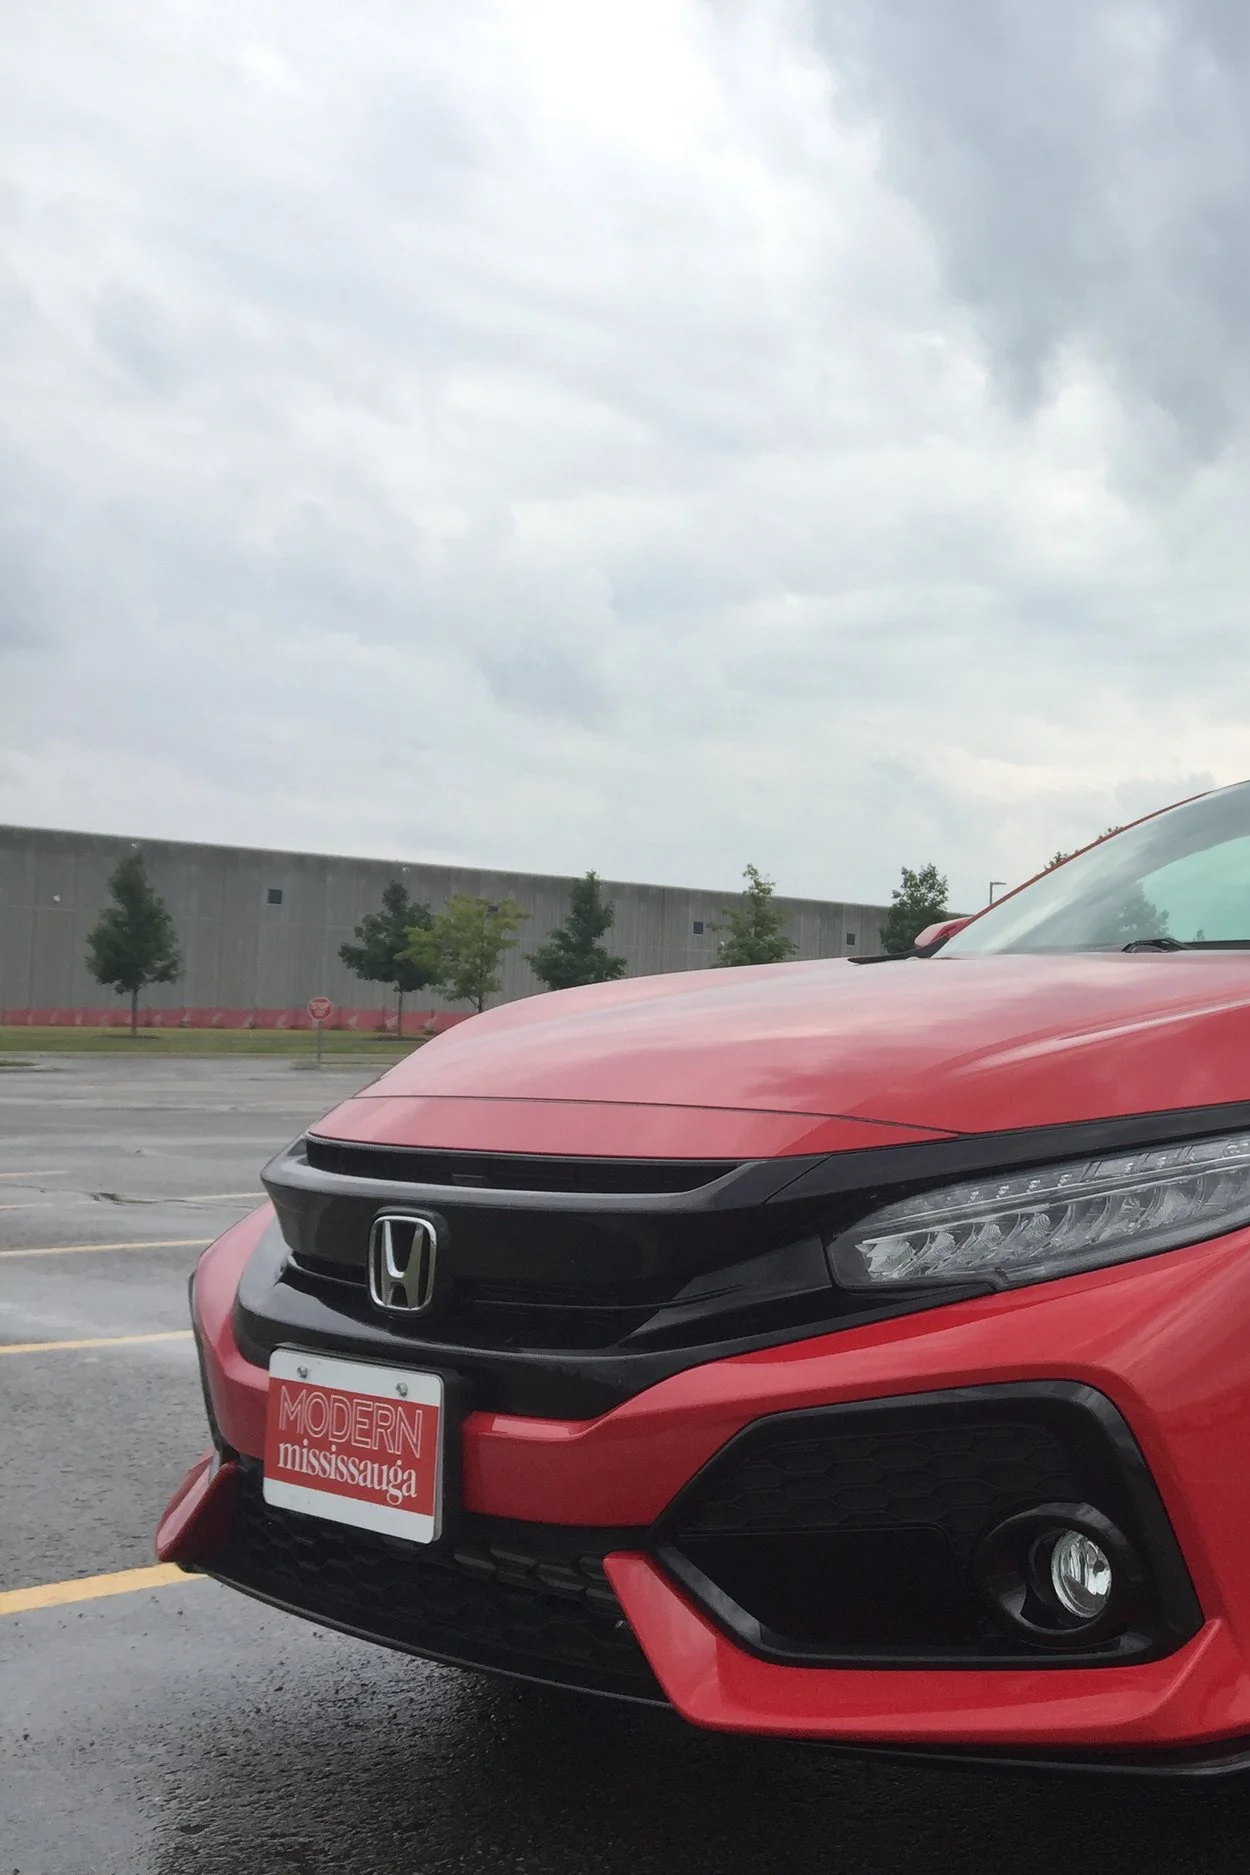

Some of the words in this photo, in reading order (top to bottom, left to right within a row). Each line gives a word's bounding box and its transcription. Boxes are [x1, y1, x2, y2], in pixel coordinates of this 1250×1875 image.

[379, 1218, 426, 1309] H
[278, 1384, 423, 1458] MODERN
[277, 1438, 417, 1506] mississauga
